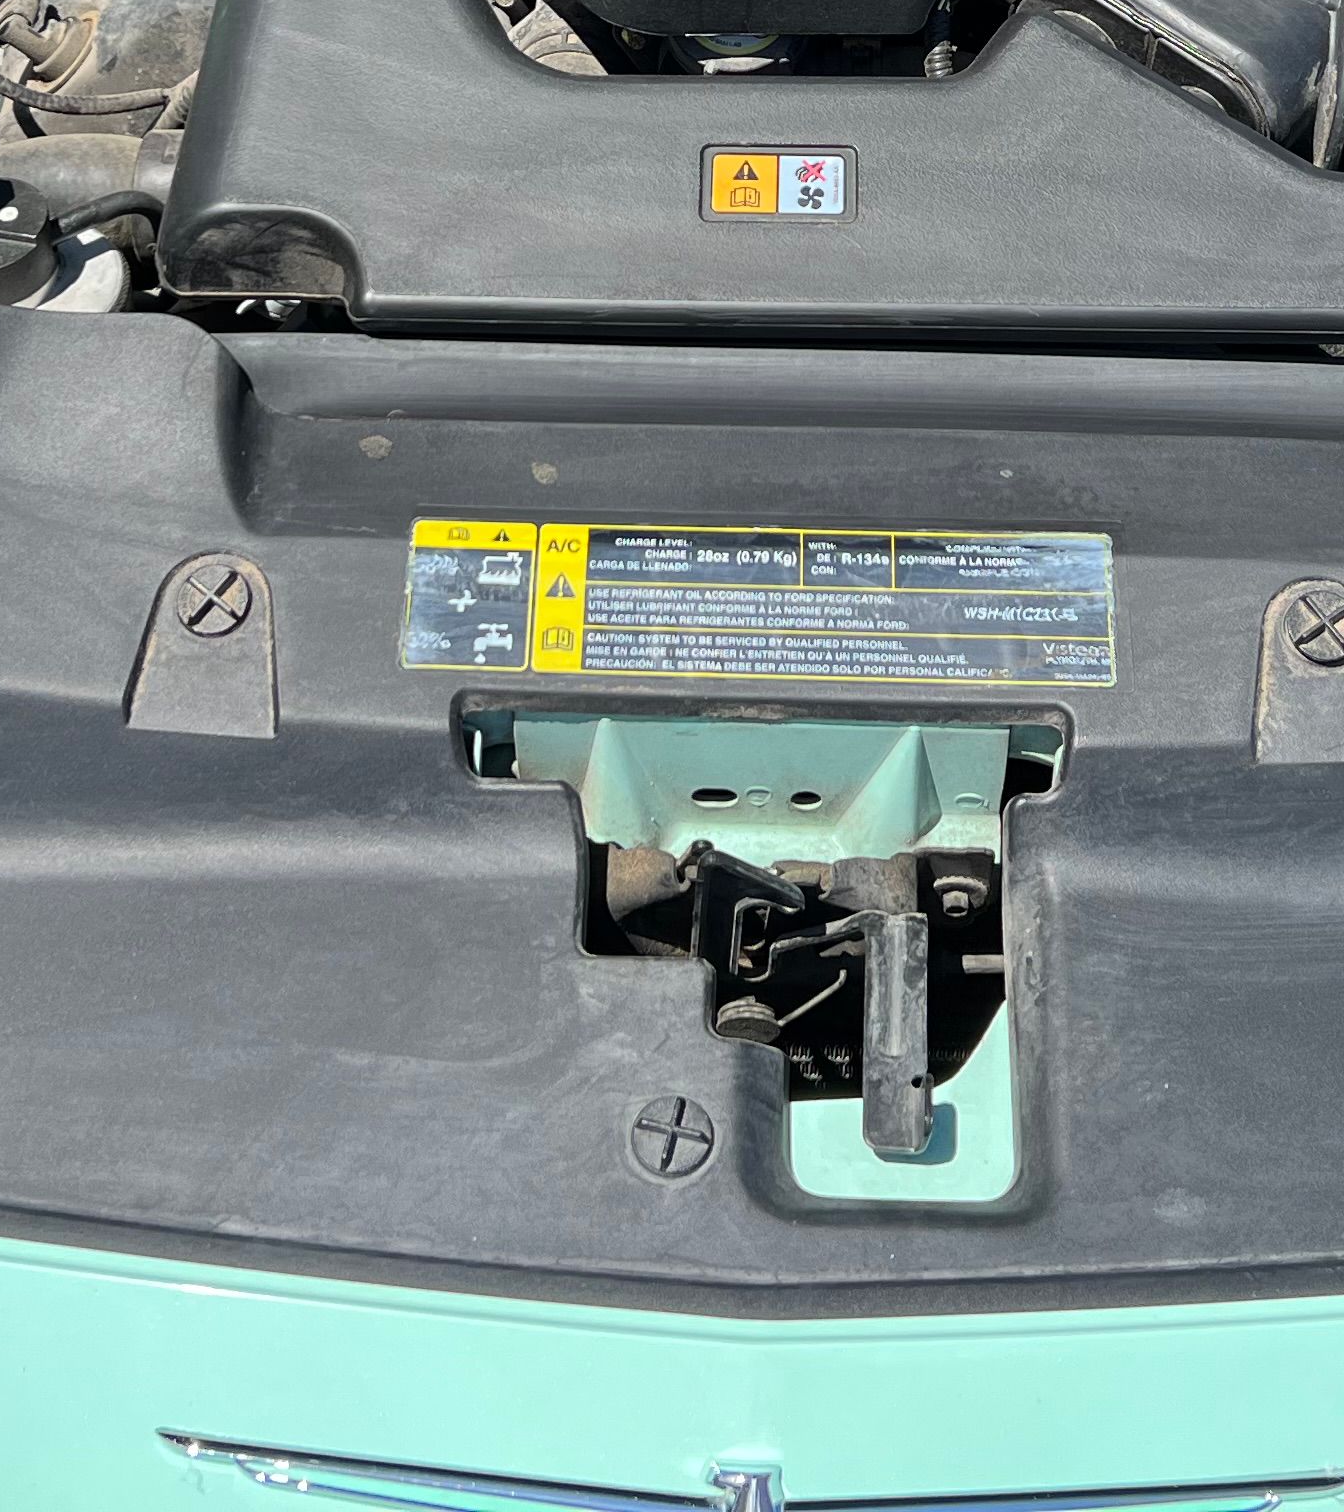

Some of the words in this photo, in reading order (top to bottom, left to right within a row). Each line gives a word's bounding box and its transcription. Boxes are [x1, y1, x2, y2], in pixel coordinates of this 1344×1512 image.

[547, 540, 581, 553] A/C
[615, 538, 656, 547] CHARGE
[659, 538, 693, 548] LEVEL:
[808, 542, 837, 551] WITH:
[645, 550, 687, 560] CHARGE
[697, 550, 730, 563] 28oz
[736, 550, 770, 565] (0.79
[773, 551, 798, 567] Kg)
[817, 553, 831, 563] DE
[841, 553, 890, 565] R-134a
[959, 555, 967, 566] À
[969, 557, 983, 566] LA
[589, 560, 625, 570] CARGA
[627, 561, 640, 570] DE
[642, 561, 693, 572] LLENADO:
[811, 565, 837, 575] CON:
[589, 588, 609, 598] USE
[612, 588, 682, 600] REFRIGERANT
[686, 590, 702, 600] OIL
[705, 590, 766, 601] ACCORDING
[768, 592, 783, 602] TO
[785, 593, 815, 603] FORD
[816, 593, 895, 605] SPECIFICATION:
[588, 600, 634, 611] UTILISER
[636, 602, 696, 613] LUBRIFIANT
[698, 603, 756, 614] CONFORME
[759, 603, 766, 614] À
[768, 605, 782, 614] LA
[784, 606, 822, 615] NORME
[824, 607, 852, 616] FORD
[588, 613, 608, 622] USE
[610, 614, 647, 624] ACEITE
[650, 615, 677, 625] PARA
[680, 616, 765, 627] REFRIGERANTES
[766, 617, 825, 628] CONFORME
[837, 620, 874, 629] NORMA
[877, 620, 910, 631] FORD:
[588, 633, 636, 644] CAUTION:
[638, 633, 680, 645] SYSTEM
[682, 635, 696, 645] TO
[699, 636, 713, 645] BE
[715, 636, 767, 646] SERVICED
[769, 637, 783, 647] BY
[785, 638, 839, 649] QUALIFIED
[842, 639, 908, 650] PERSONNEL.
[586, 646, 611, 656] MISE
[613, 647, 628, 656] EN
[630, 647, 667, 657] GARDE
[675, 648, 689, 657] NE
[691, 648, 737, 658] CONFIER
[739, 649, 805, 660] L'ENTRETIEN
[836, 652, 850, 661] UN
[853, 652, 916, 663] PERSONNEL
[1043, 642, 1110, 657] Visteon
[662, 660, 675, 669] EL
[677, 660, 722, 670] SISTEMA
[724, 661, 752, 671] DEBE
[755, 662, 776, 672] SER
[778, 663, 830, 673] ATENDIDO
[832, 664, 861, 674] SOLO
[863, 665, 886, 675] POR
[889, 667, 944, 677] PERSONAL
[947, 667, 1012, 678] CALIFICO.
